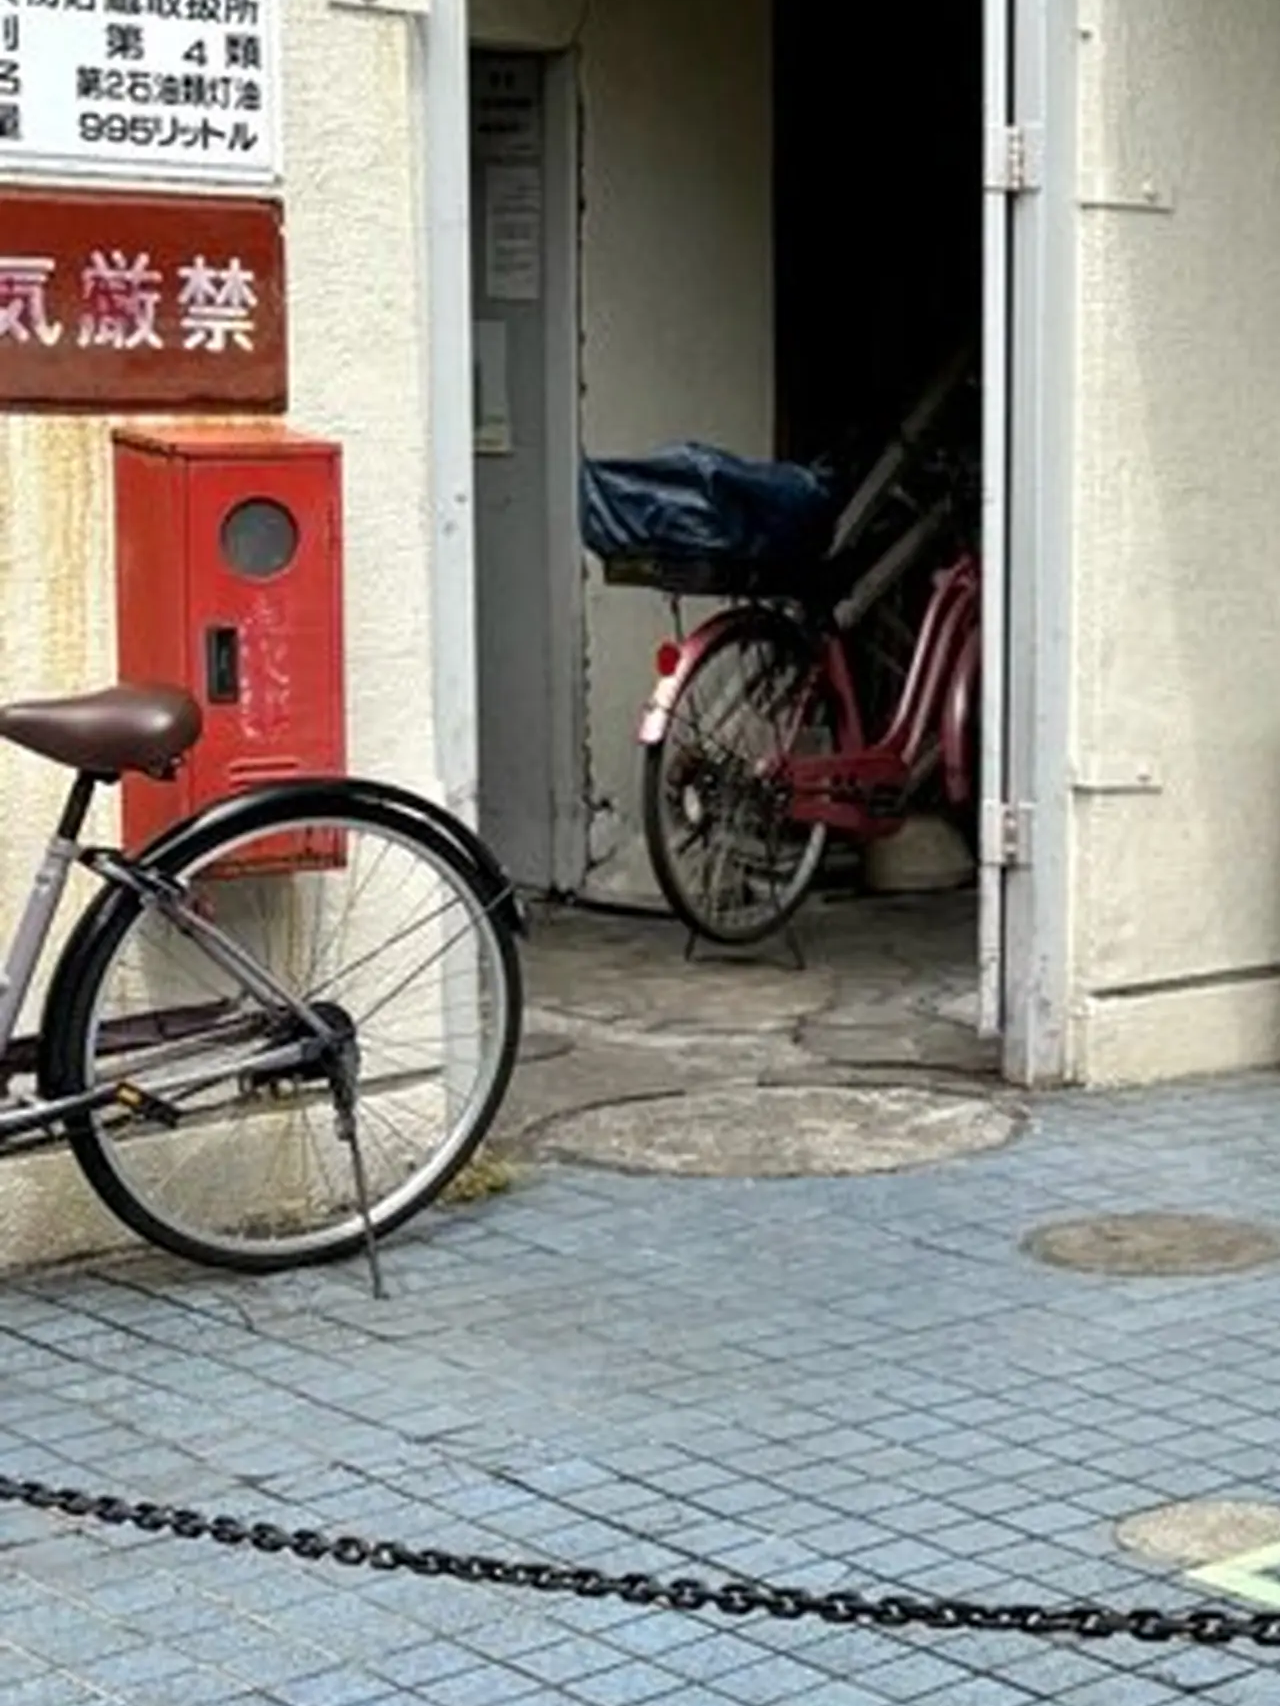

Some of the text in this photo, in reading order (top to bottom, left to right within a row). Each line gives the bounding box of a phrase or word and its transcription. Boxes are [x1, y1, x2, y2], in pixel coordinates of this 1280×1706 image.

[105, 22, 262, 71] 第 4 類
[78, 111, 259, 151] 995リットル
